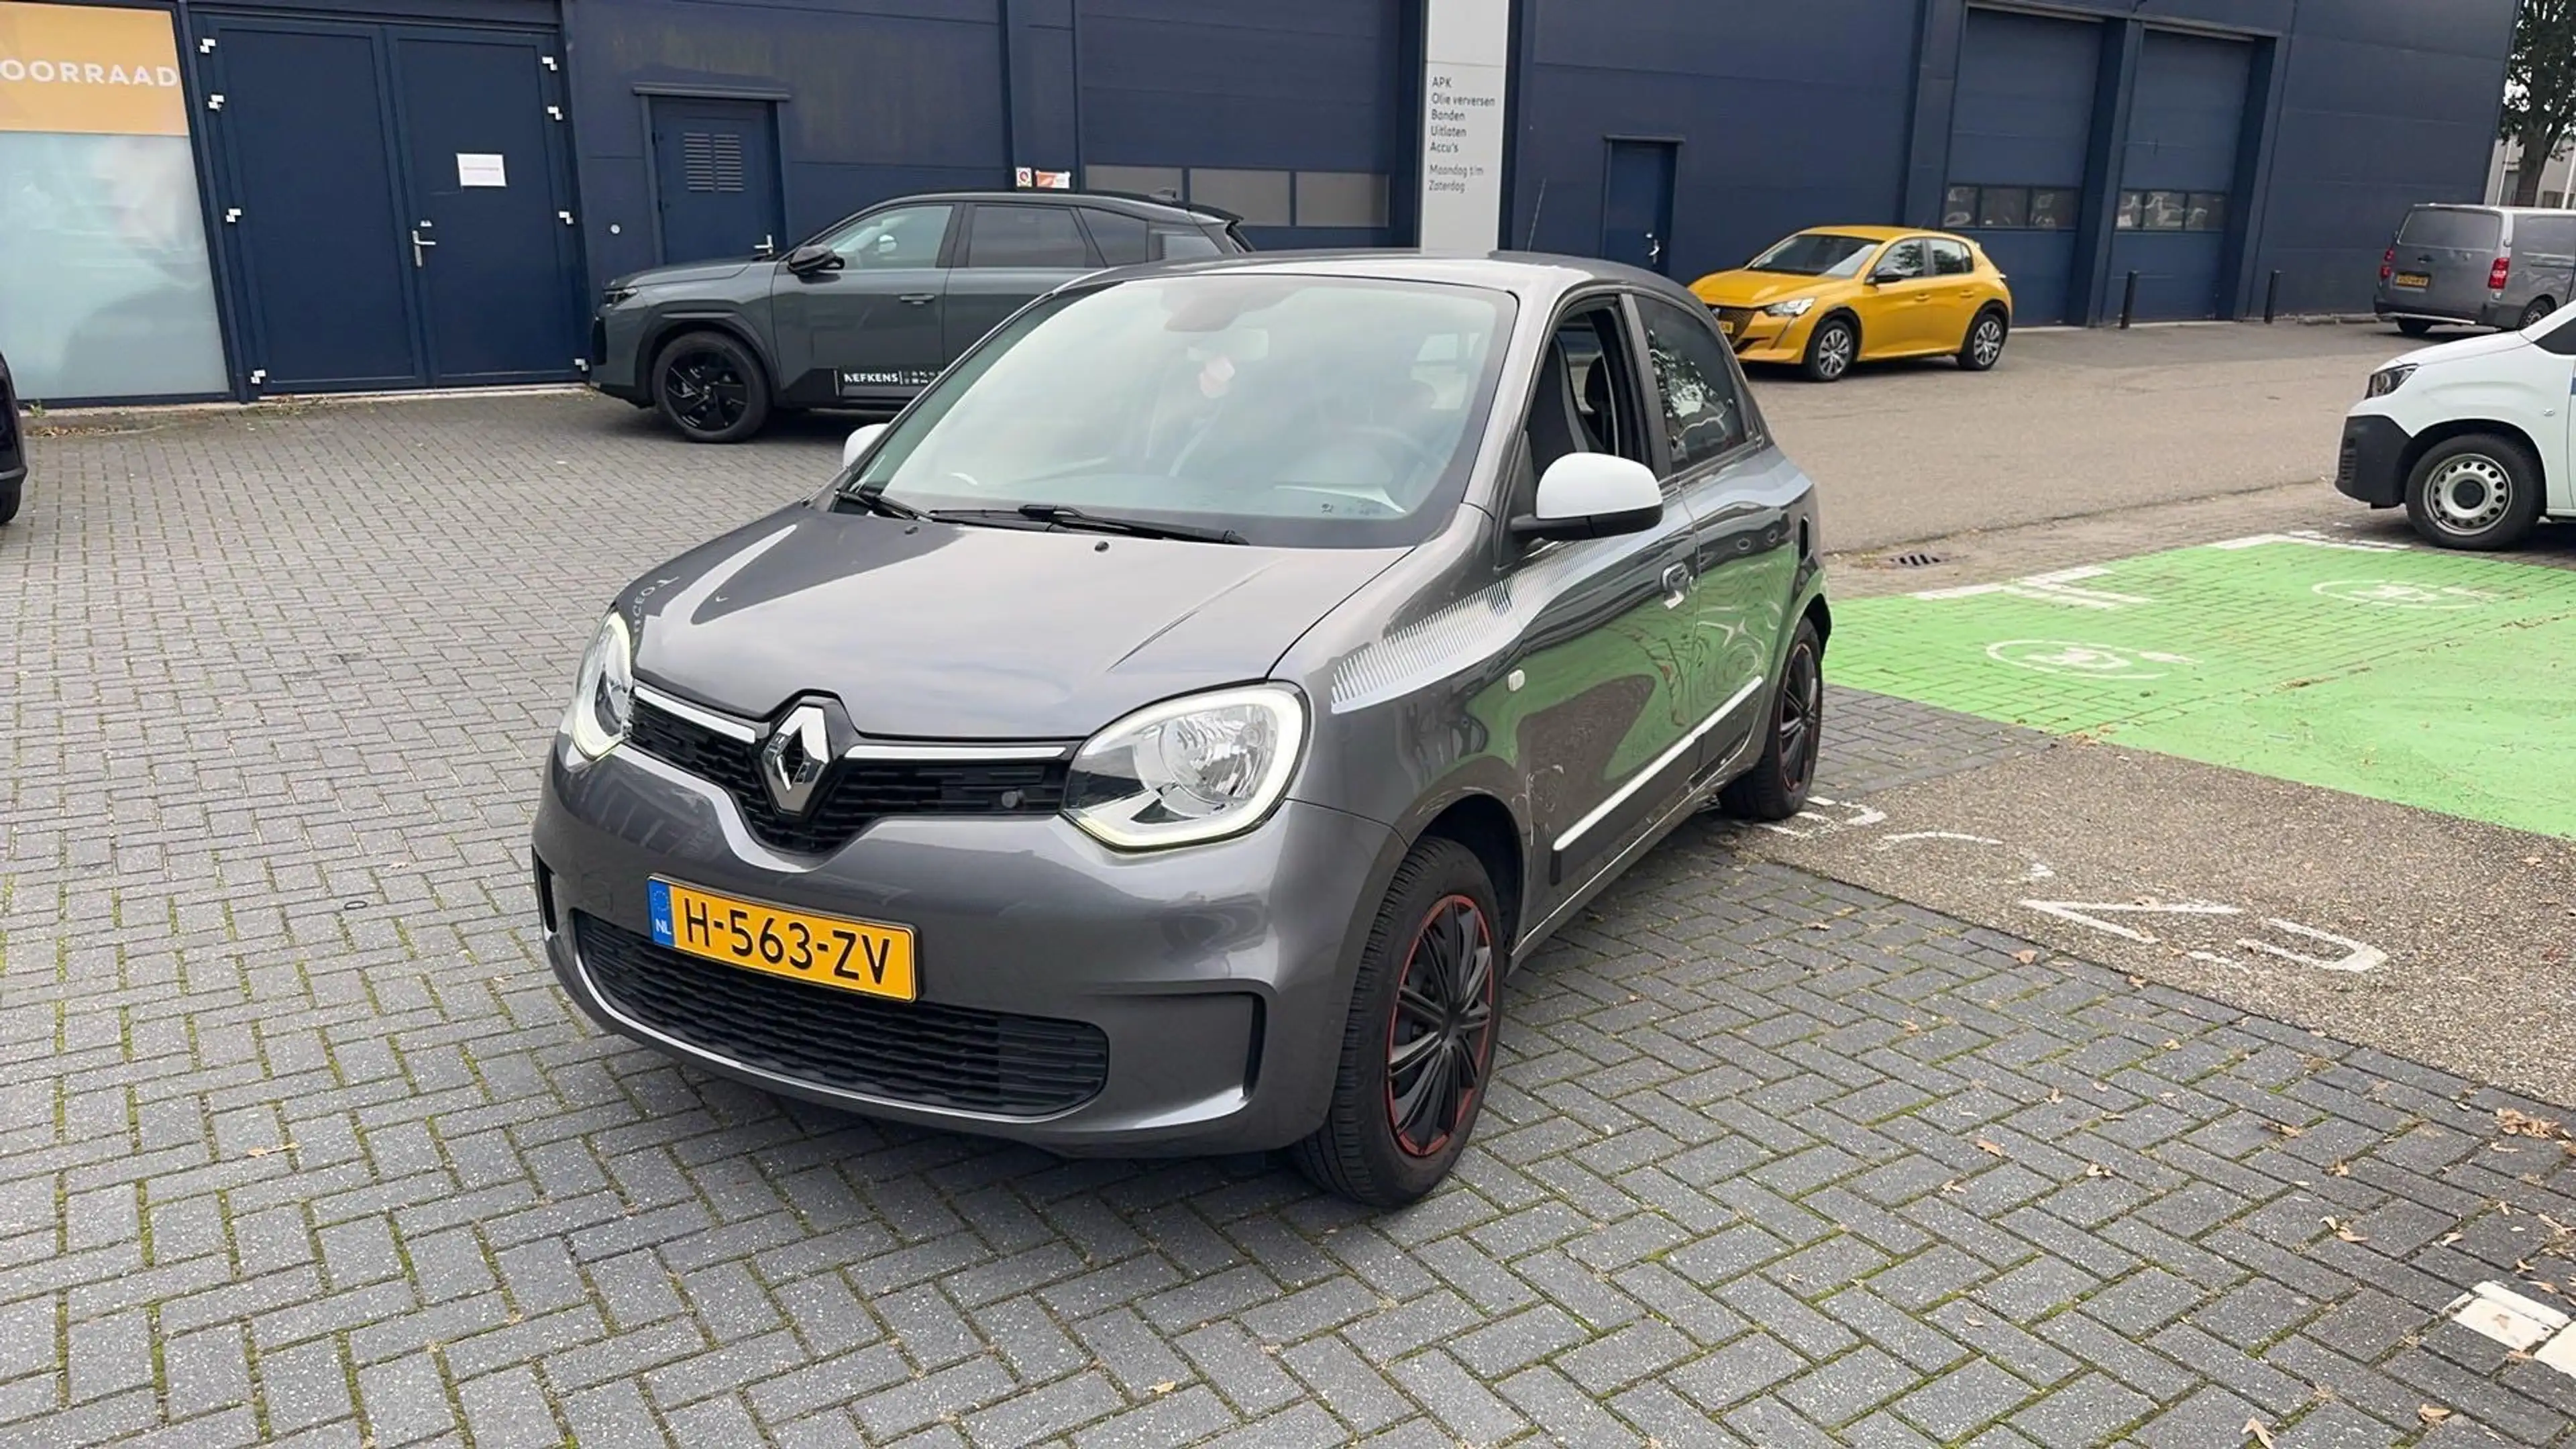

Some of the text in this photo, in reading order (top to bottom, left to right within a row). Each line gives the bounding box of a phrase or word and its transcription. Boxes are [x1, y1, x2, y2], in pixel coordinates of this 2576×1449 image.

[0, 58, 178, 87] OORRAAD
[1432, 75, 1452, 88] APK
[1432, 93, 1495, 107] Olie verversen
[1432, 109, 1465, 121] Banden
[1430, 142, 1459, 153] Accu's
[655, 918, 672, 935] NL
[684, 897, 891, 985] H-563-ZV
